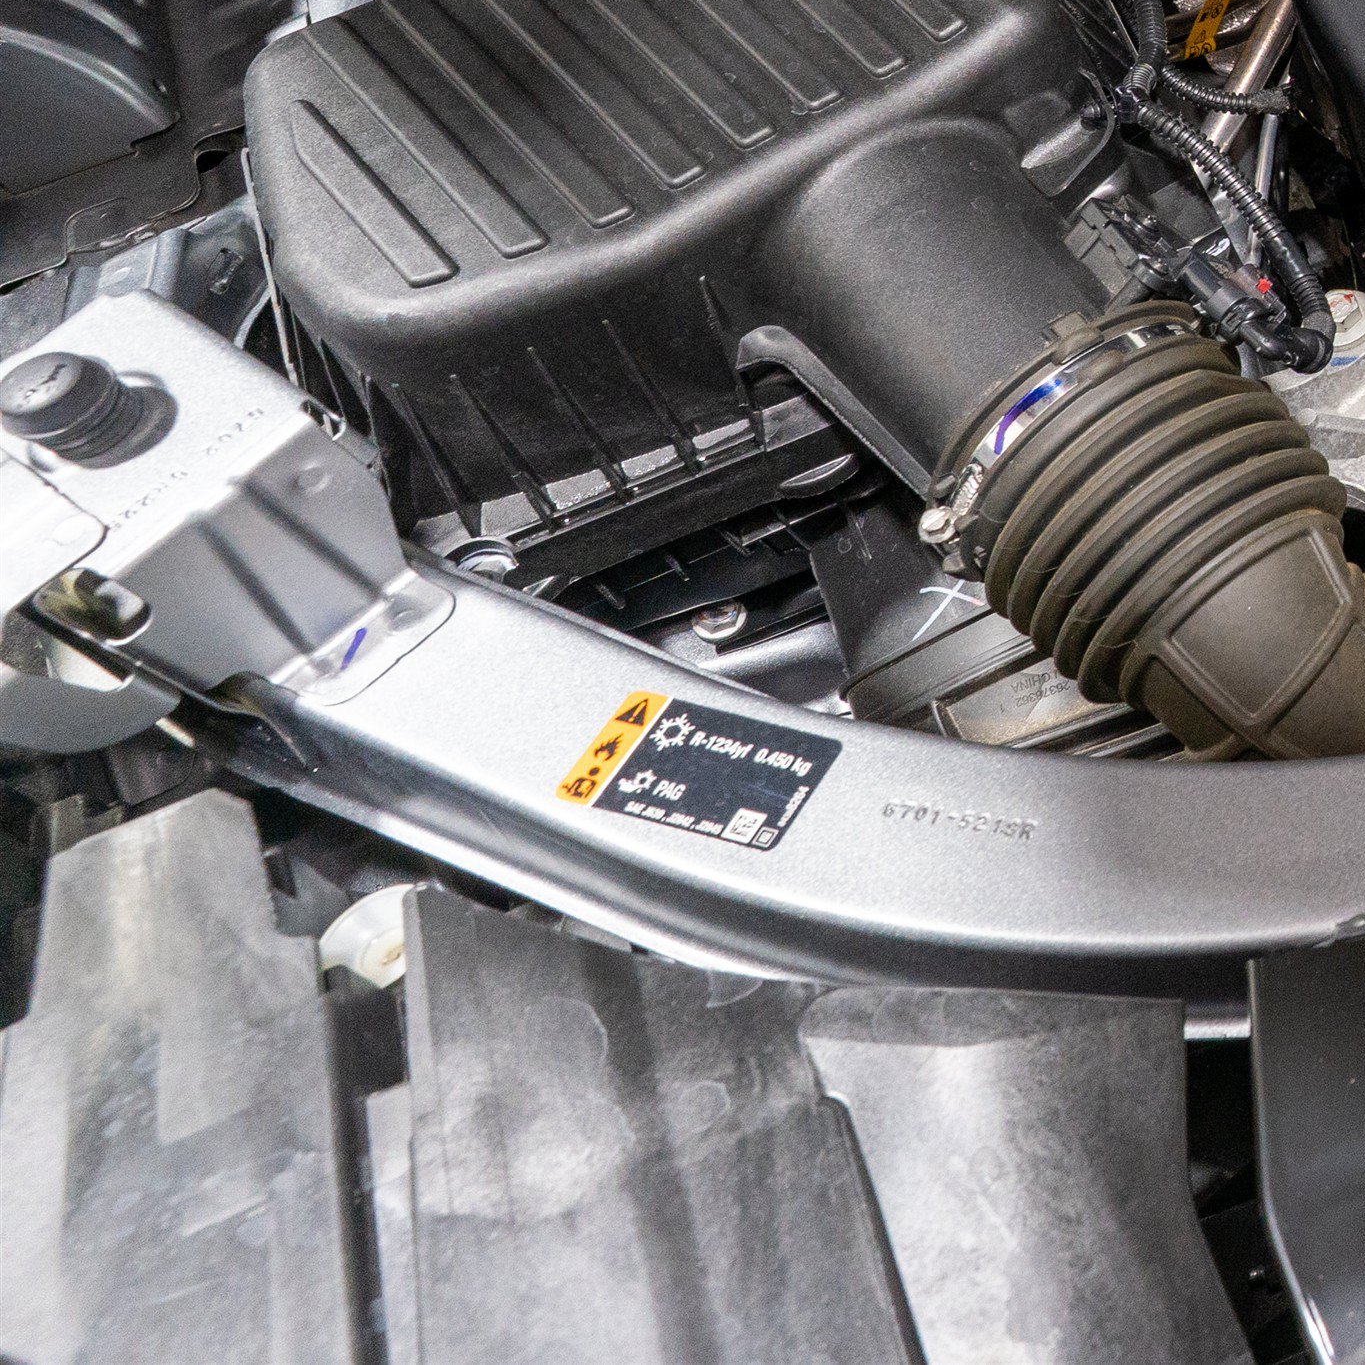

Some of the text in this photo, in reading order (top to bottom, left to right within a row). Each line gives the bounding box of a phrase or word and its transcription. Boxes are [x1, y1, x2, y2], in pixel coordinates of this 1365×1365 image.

[688, 730, 813, 777] R-1234yf 0.450 kg
[652, 777, 687, 802] PAG
